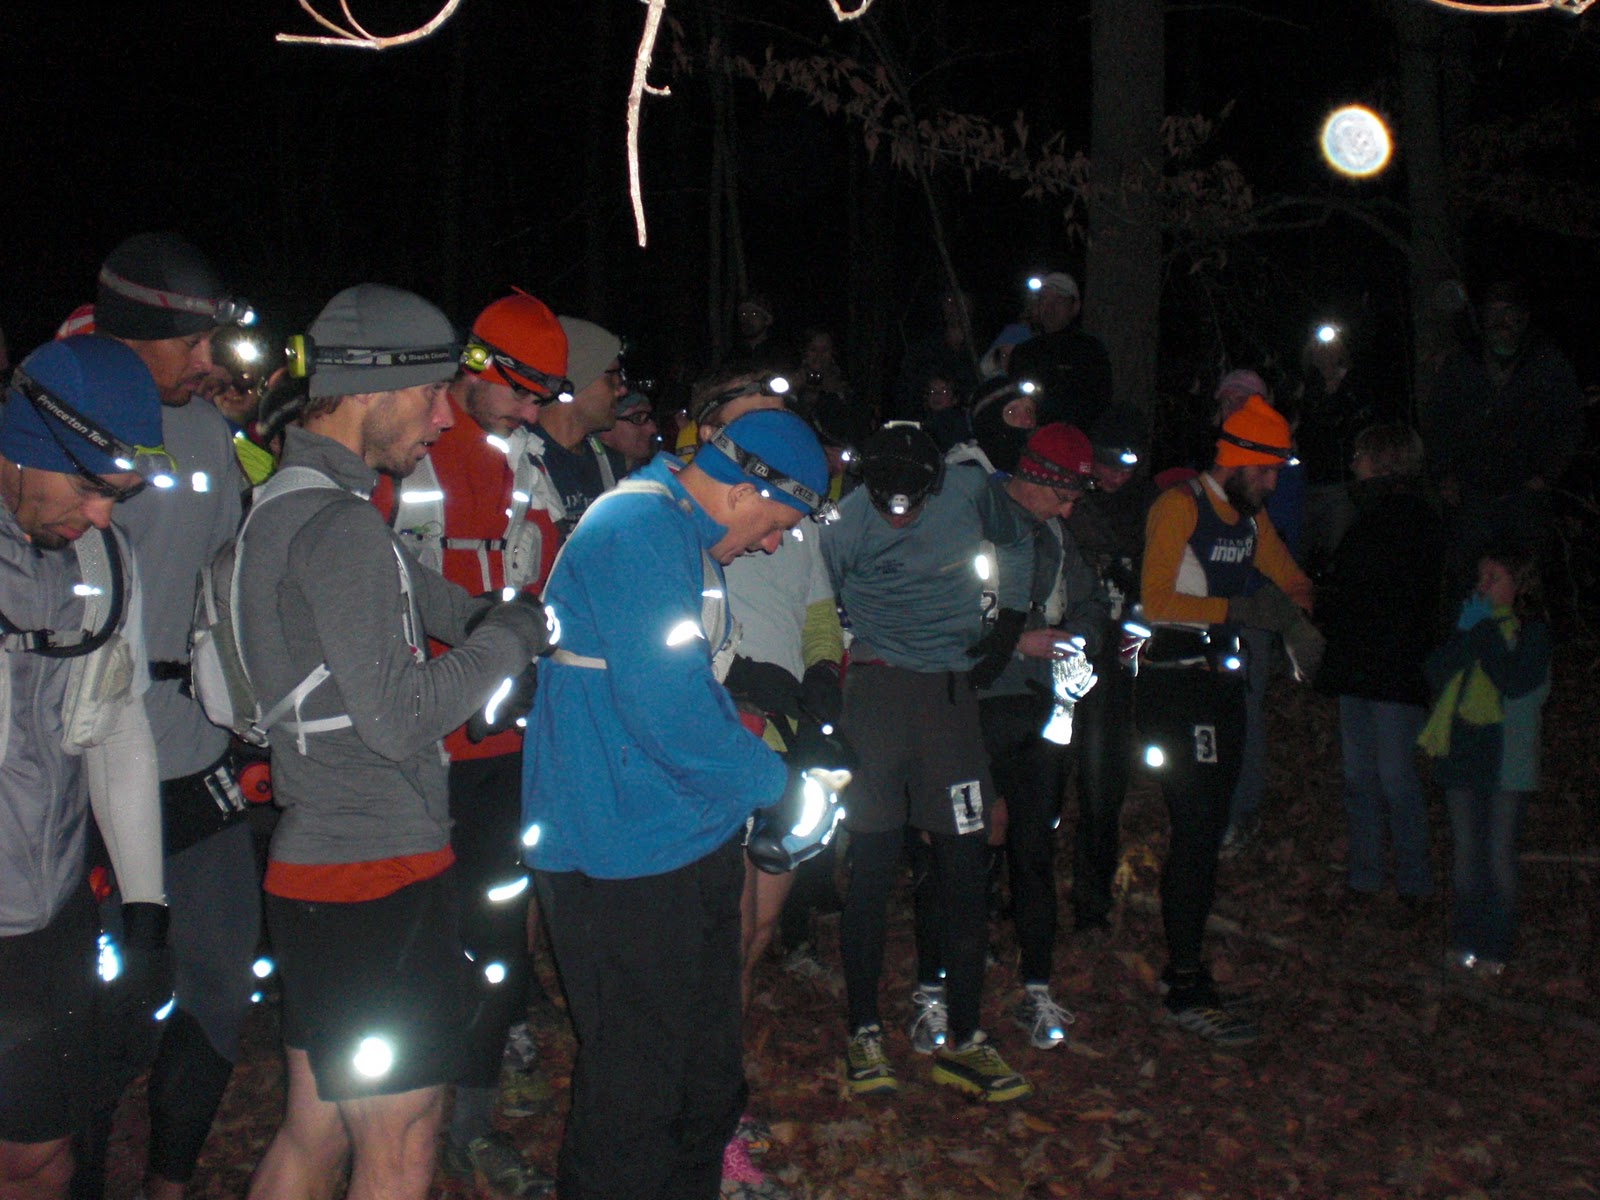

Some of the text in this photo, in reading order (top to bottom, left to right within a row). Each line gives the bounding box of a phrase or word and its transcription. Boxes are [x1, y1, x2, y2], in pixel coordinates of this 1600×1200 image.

[37, 394, 109, 447] Princeton Tec
[793, 485, 814, 502] PETZL
[982, 591, 997, 624] 2
[1200, 730, 1212, 759] 3
[961, 785, 976, 819] 1
